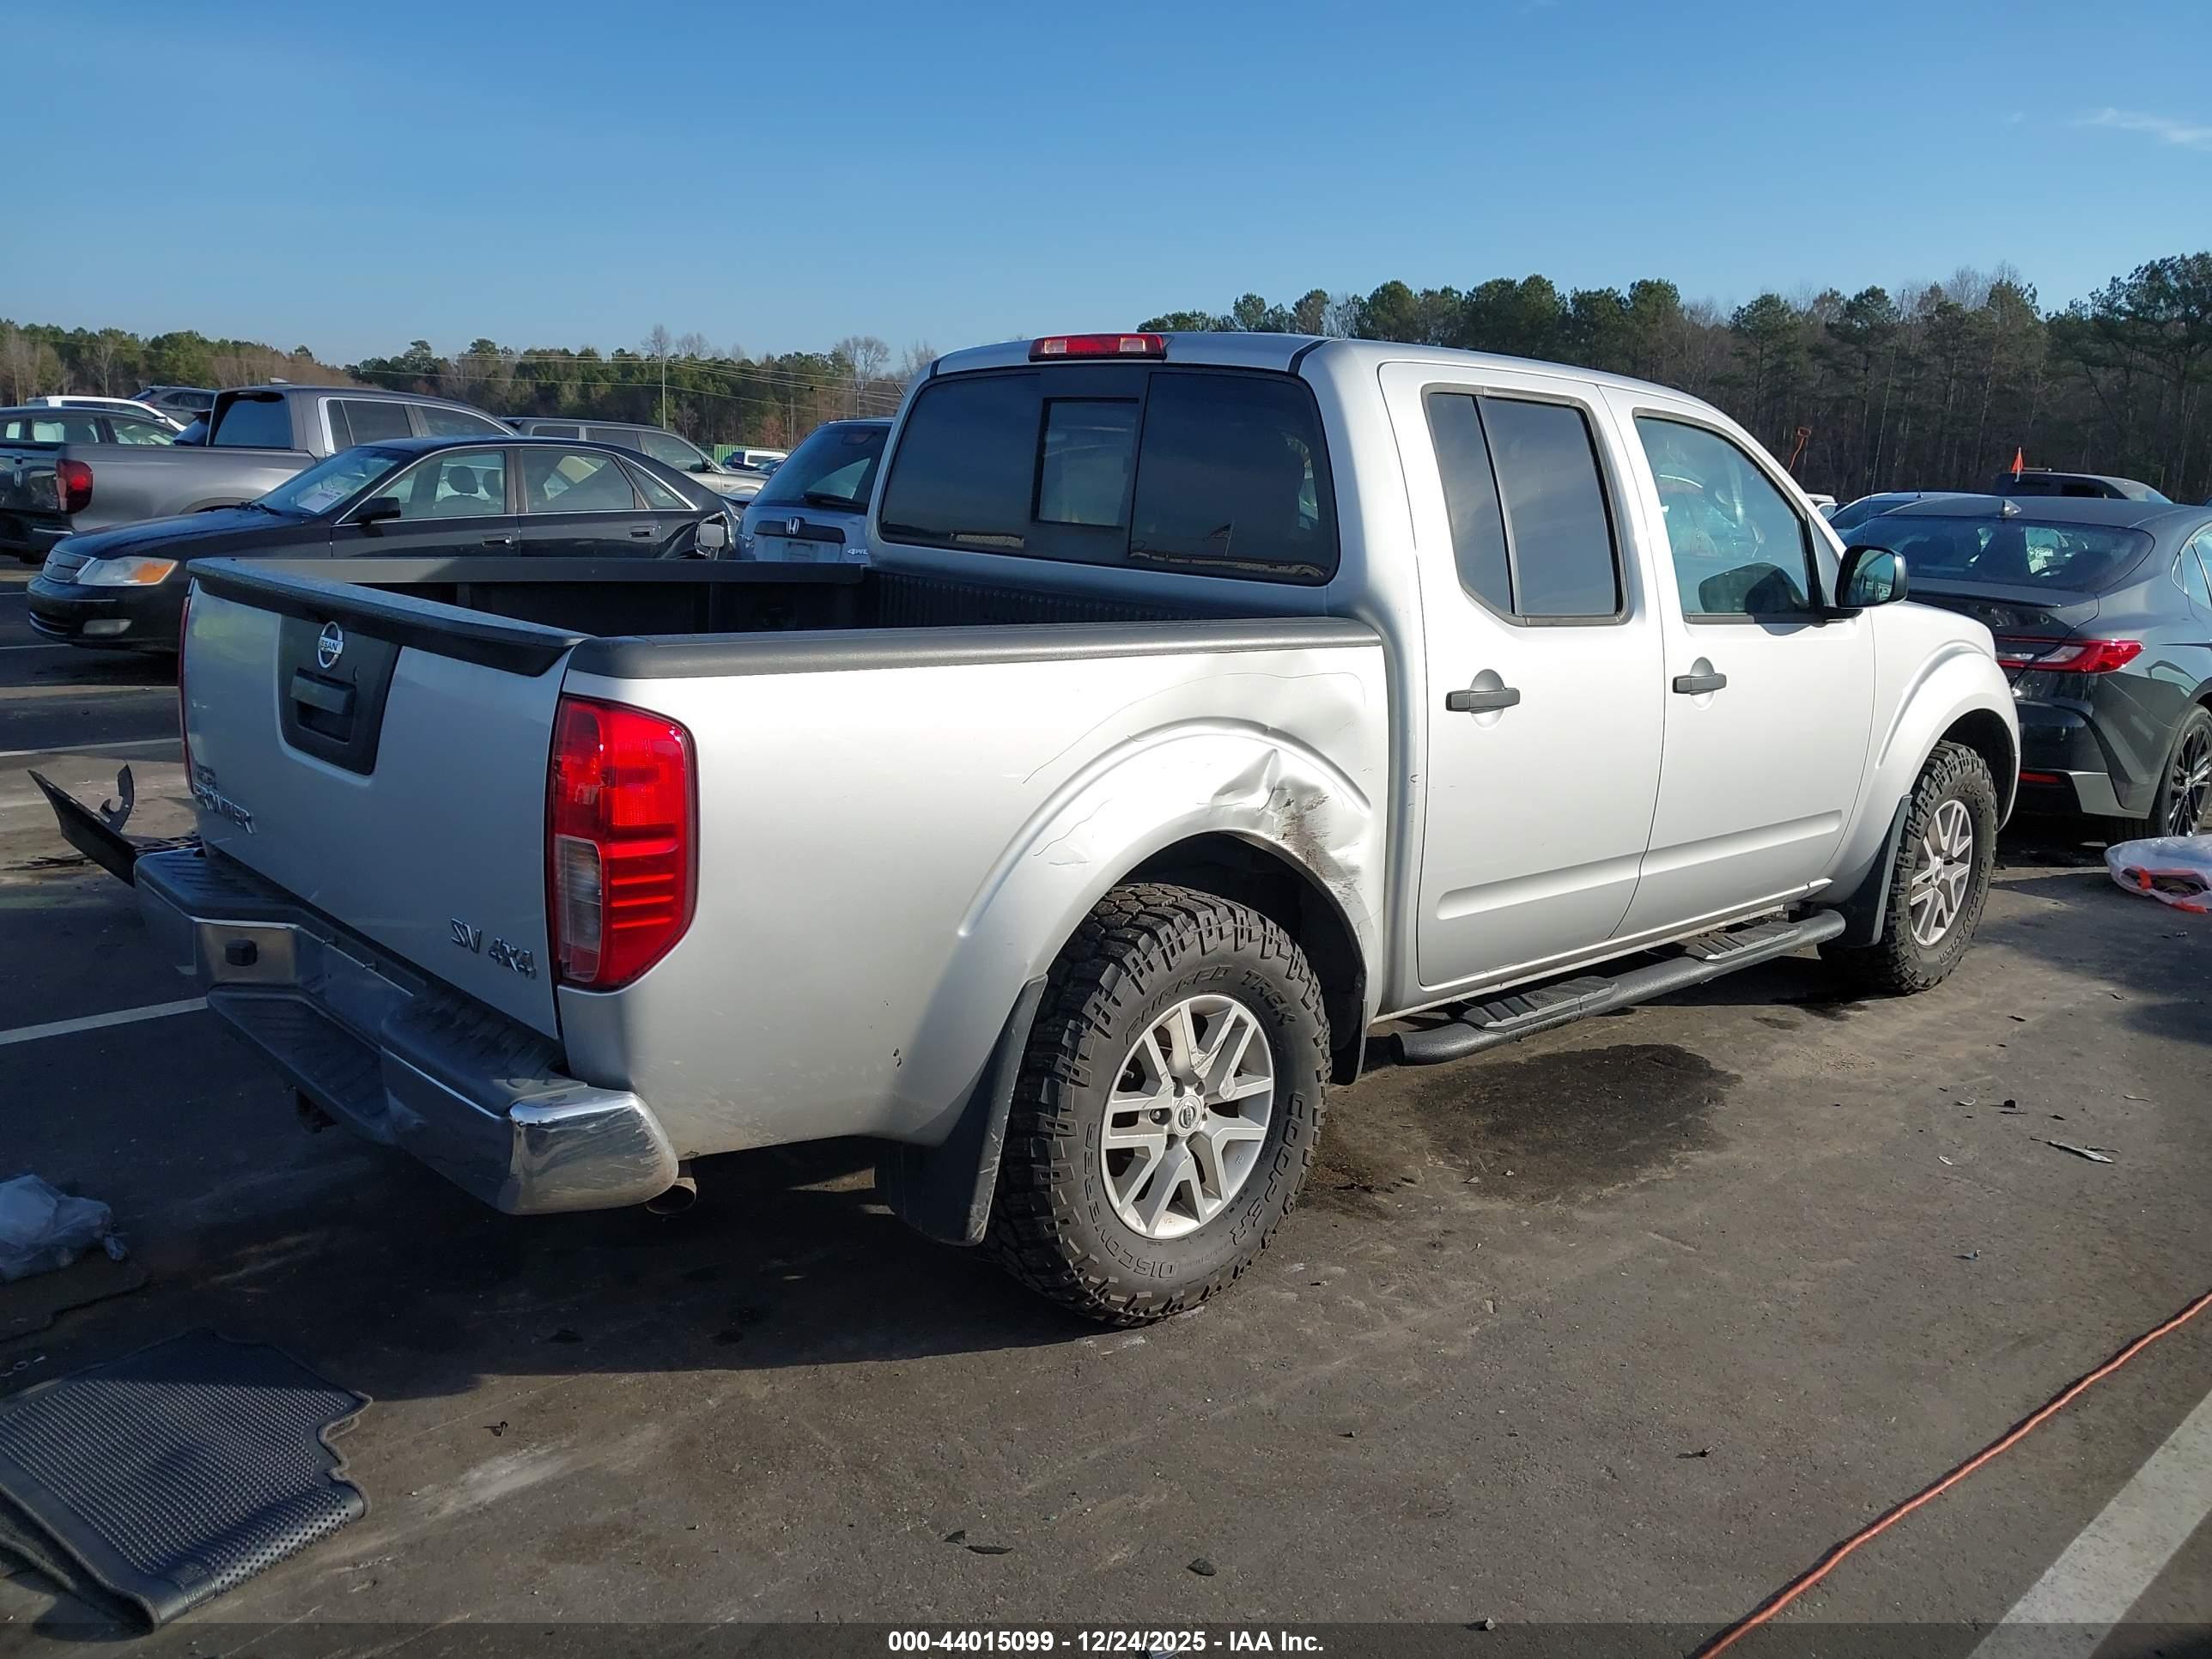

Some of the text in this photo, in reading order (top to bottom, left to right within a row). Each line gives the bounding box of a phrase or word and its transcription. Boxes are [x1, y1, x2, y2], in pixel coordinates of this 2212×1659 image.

[451, 917, 482, 954] SV
[1241, 968, 1297, 1027] TREK
[1084, 1121, 1179, 1279] DISCOVERER
[1229, 1091, 1306, 1246] COOPER
